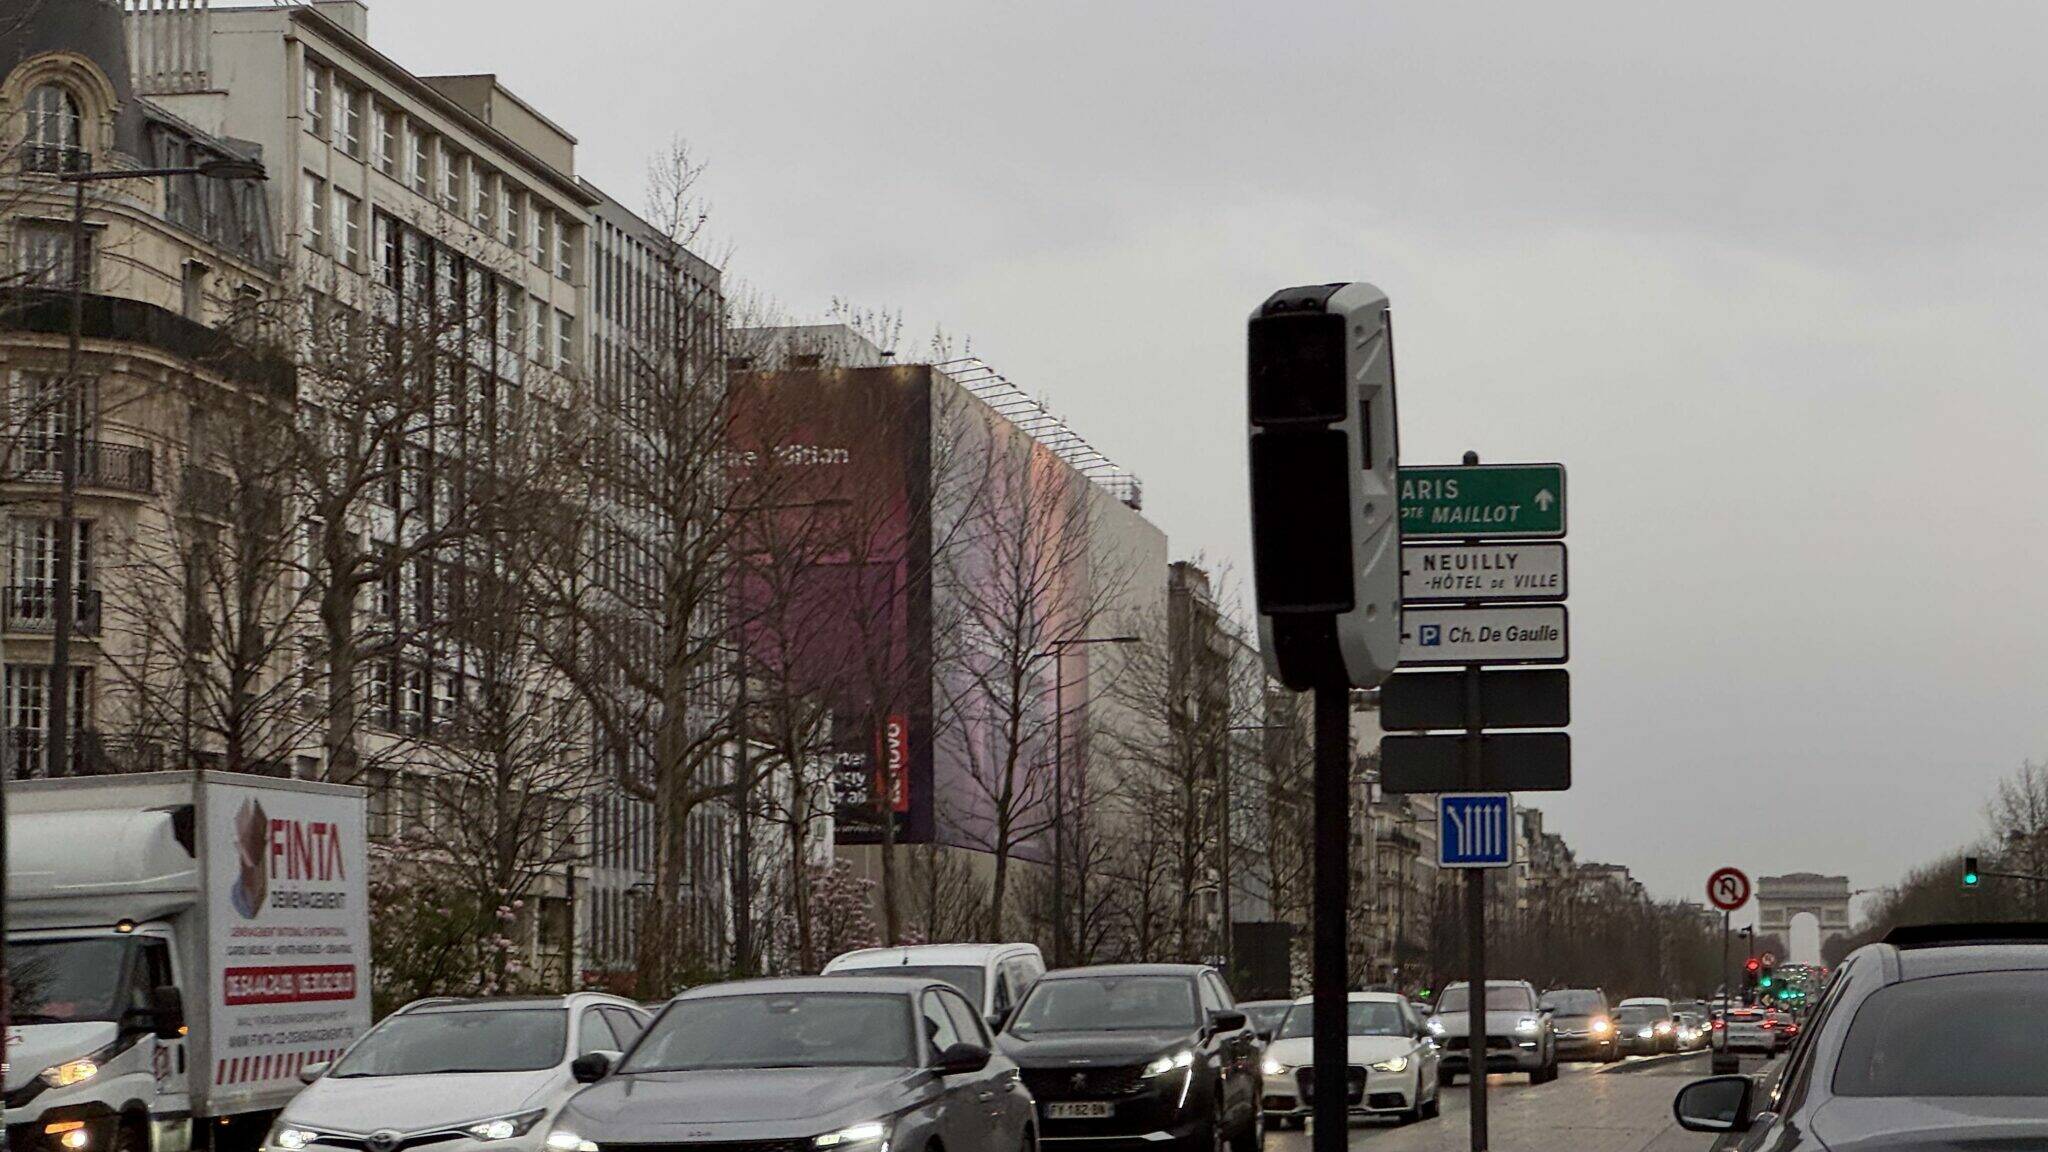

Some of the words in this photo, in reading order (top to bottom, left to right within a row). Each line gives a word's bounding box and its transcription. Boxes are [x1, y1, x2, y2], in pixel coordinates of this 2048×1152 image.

[1401, 479, 1459, 500] ARIS
[1431, 505, 1521, 524] MAILLOT
[1423, 553, 1519, 571] NEUILLY
[1514, 574, 1558, 588] VILLE
[1449, 627, 1475, 643] Ch.
[1479, 627, 1501, 642] De
[1506, 625, 1559, 642] Gaulle
[269, 818, 346, 881] FINTA
